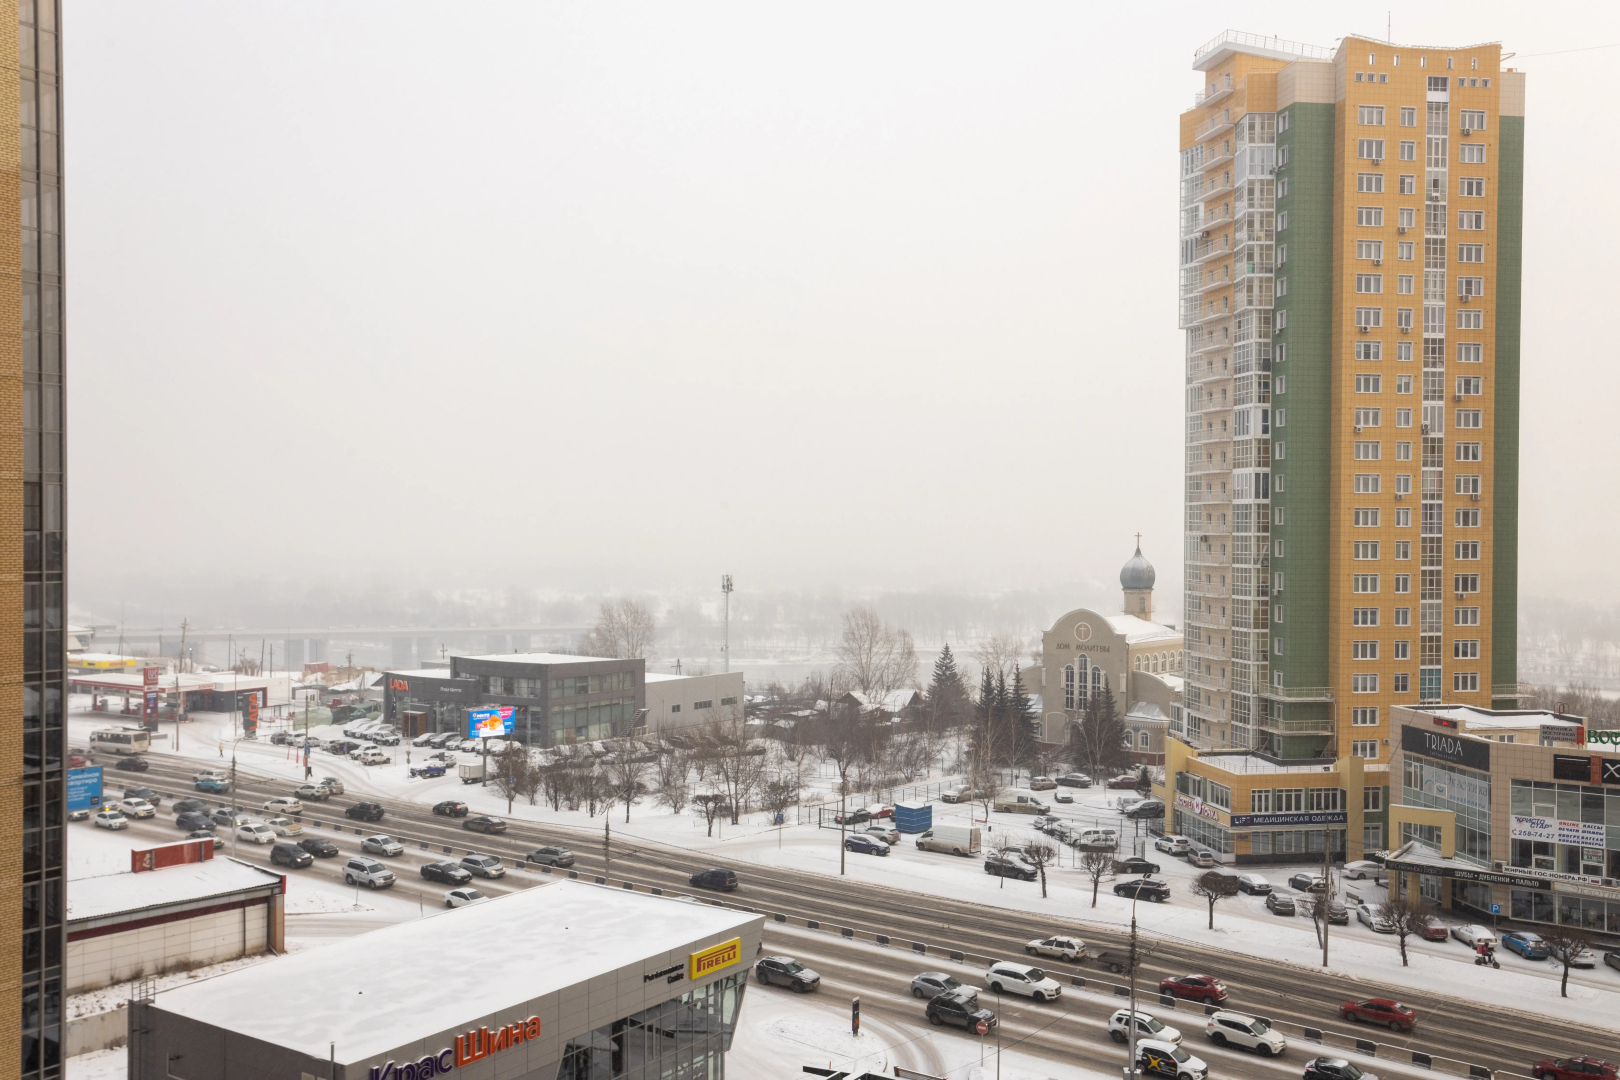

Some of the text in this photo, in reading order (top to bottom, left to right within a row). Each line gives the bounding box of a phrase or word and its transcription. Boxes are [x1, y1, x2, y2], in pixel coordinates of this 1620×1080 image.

[1075, 644, 1110, 652] МОЛИТВЫ
[390, 678, 408, 691] LADA
[249, 693, 258, 730] LADA
[1424, 733, 1463, 756] TRIADA
[1253, 814, 1344, 824] МЕДИЦИНСКАЯ ОДЕЖДА
[1518, 830, 1555, 839] 258-74-27
[1454, 870, 1539, 887] ШУБЫ ДУБЛЕНКИ ПАЛЬТО
[696, 944, 737, 973] PIRELLI
